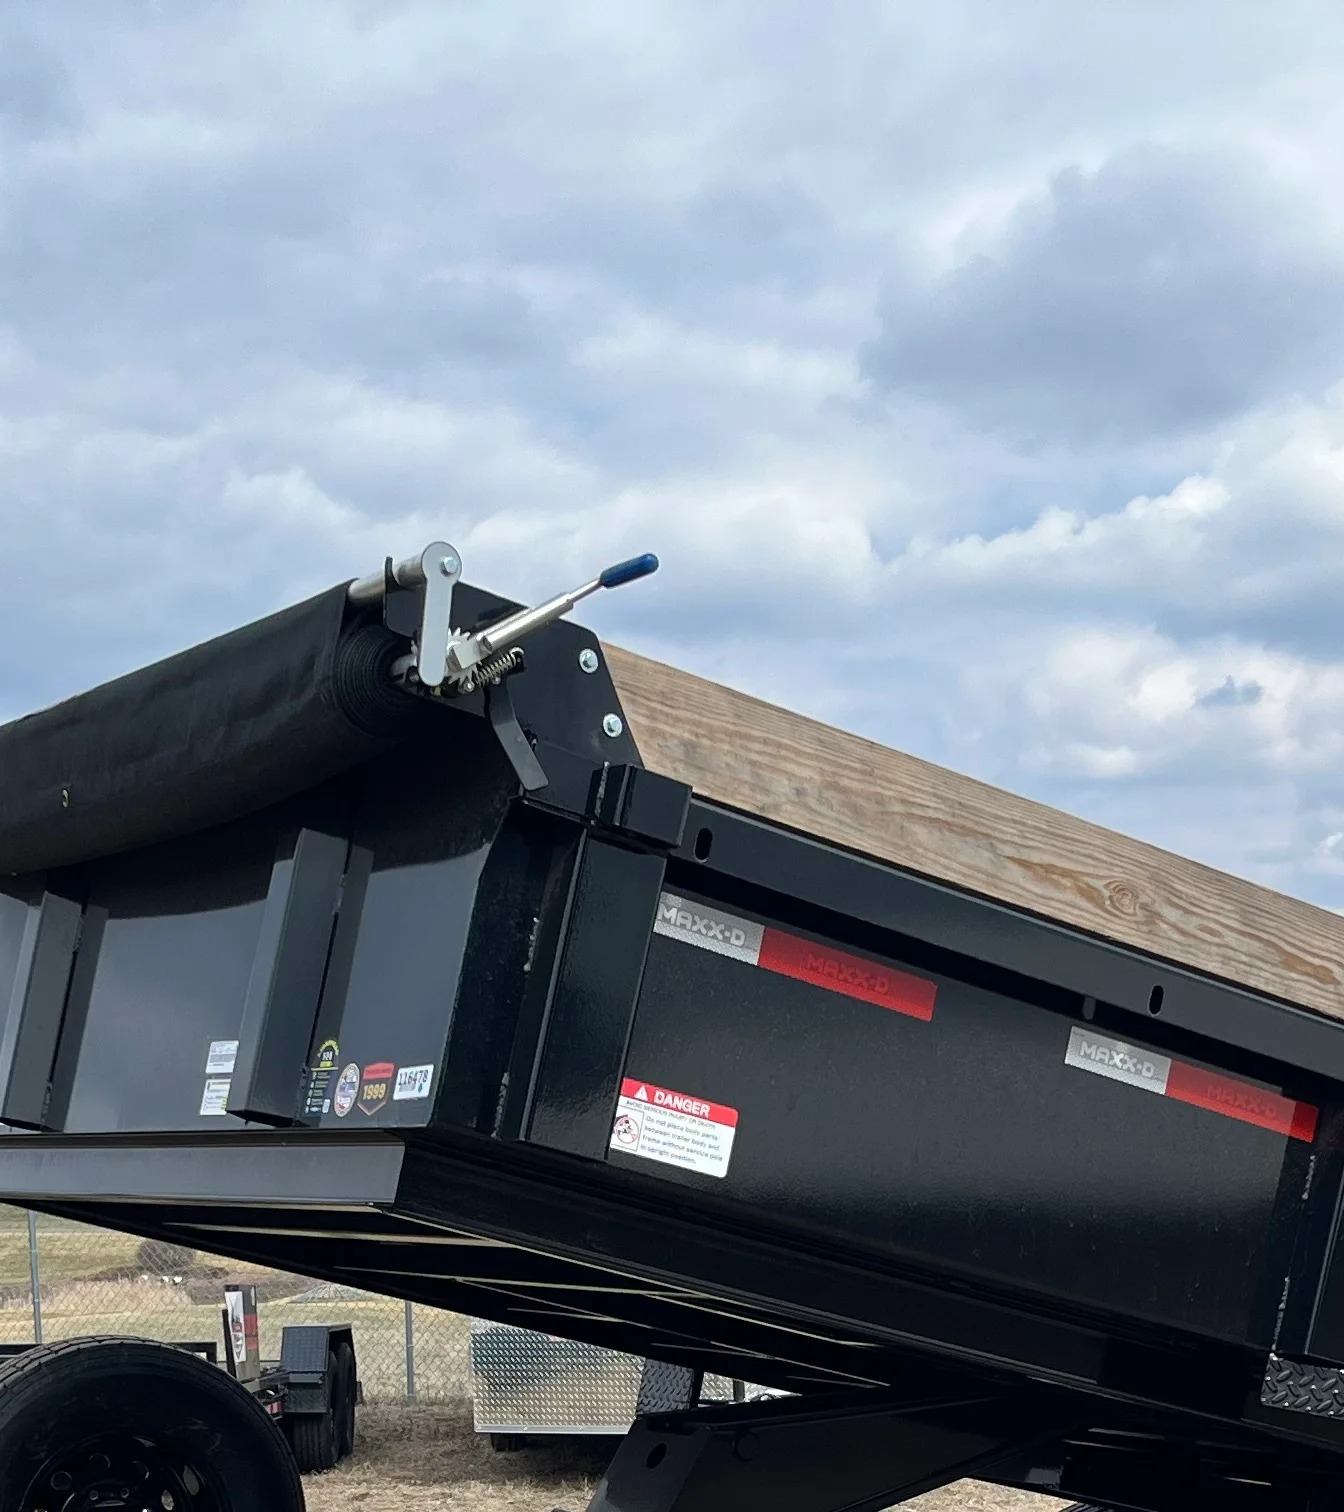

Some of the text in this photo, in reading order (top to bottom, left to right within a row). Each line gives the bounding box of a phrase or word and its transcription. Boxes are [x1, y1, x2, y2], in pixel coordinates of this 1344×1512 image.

[657, 903, 889, 993] MAXX-D MAXX-D
[1079, 1041, 1155, 1077] MAXX-D
[363, 1083, 387, 1100] 1999
[654, 1091, 711, 1118] DANGER
